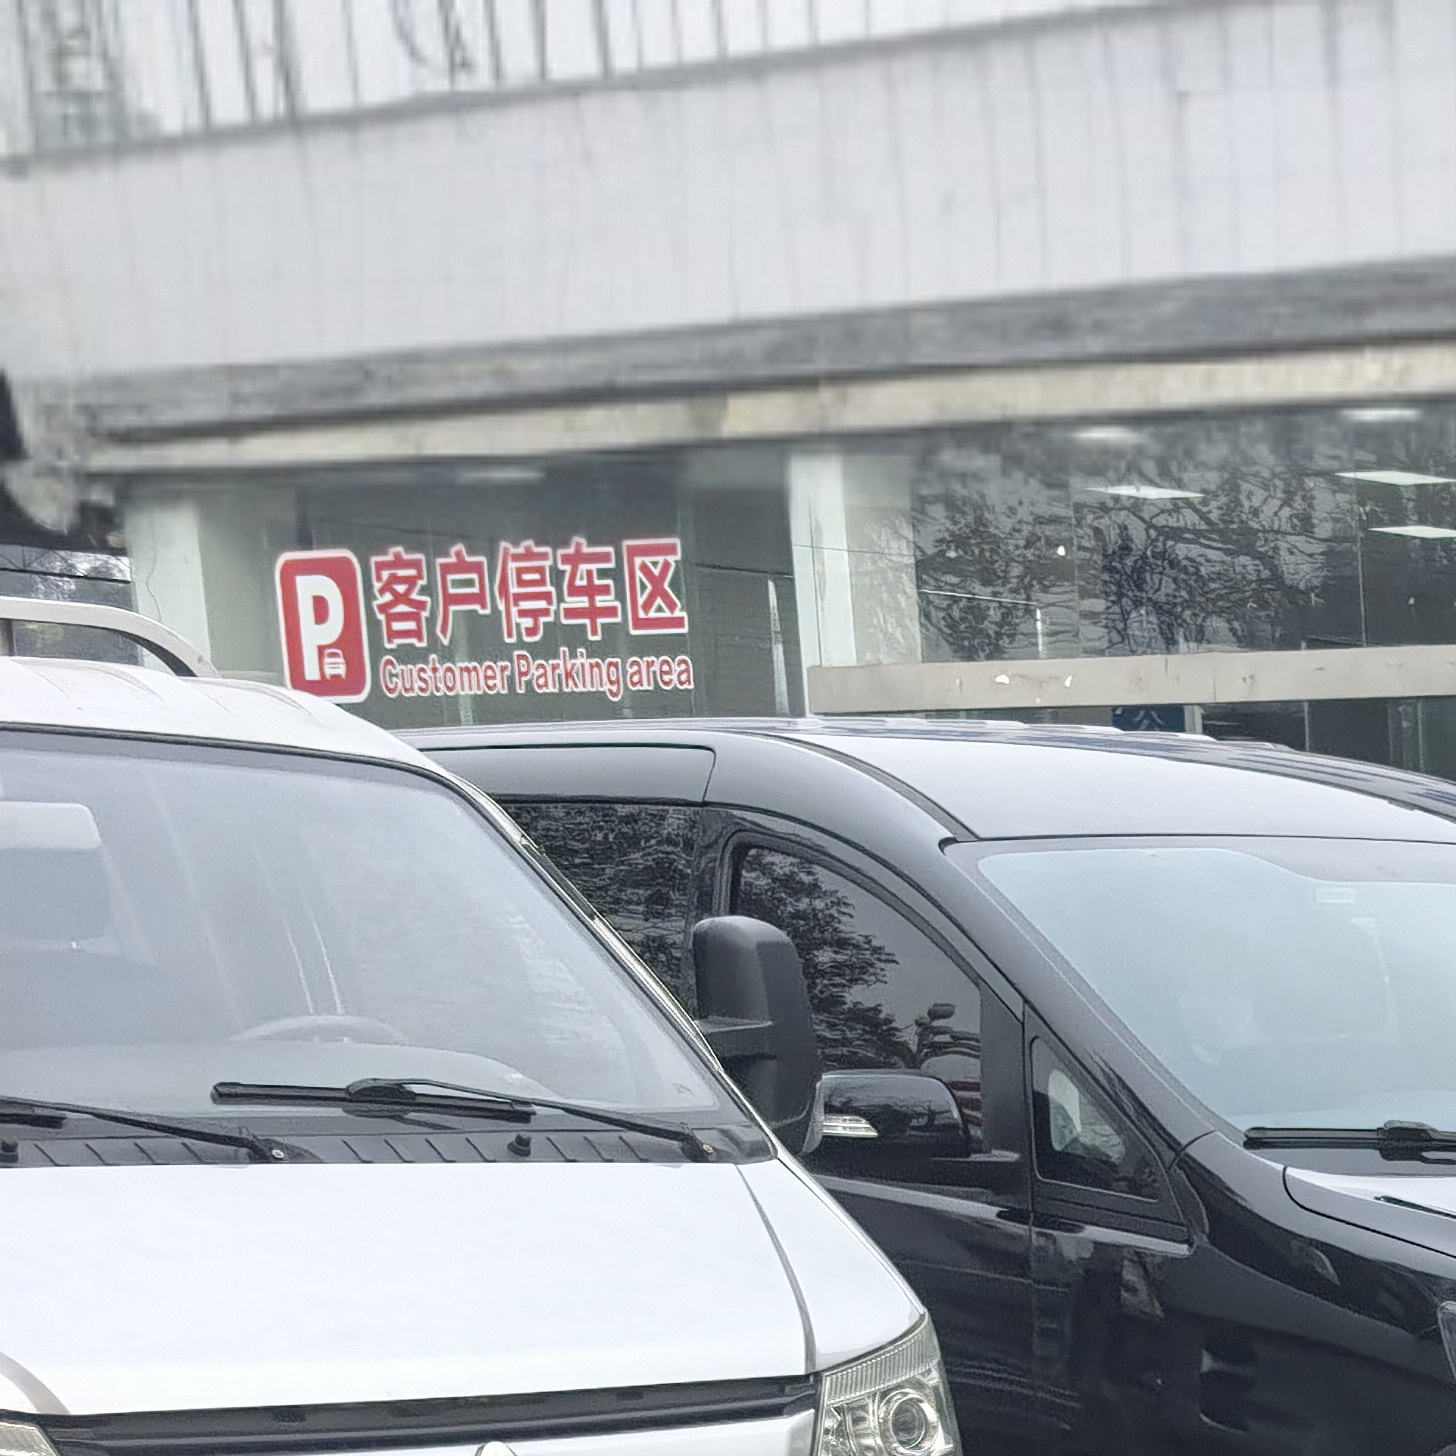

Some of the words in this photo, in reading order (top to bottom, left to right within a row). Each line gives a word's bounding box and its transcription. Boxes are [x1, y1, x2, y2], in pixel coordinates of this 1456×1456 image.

[370, 538, 688, 647] 客户停车区
[380, 656, 510, 697] Customer
[516, 648, 623, 700] Parking
[627, 656, 694, 690] area
